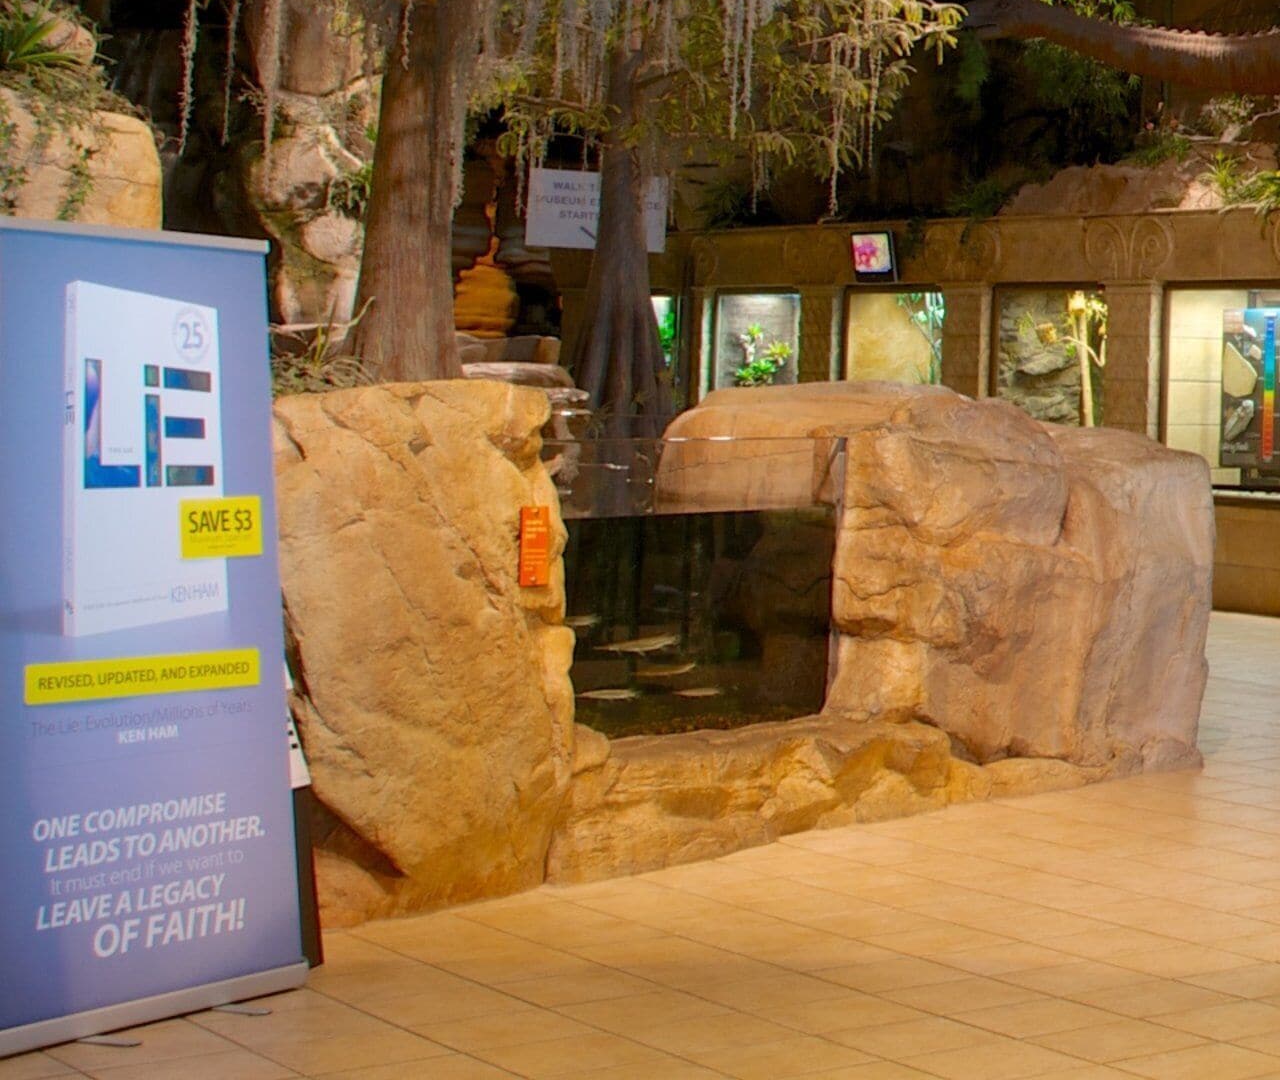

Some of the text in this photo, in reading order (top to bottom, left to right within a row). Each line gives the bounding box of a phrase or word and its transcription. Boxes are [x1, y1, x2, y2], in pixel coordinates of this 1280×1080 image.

[179, 322, 204, 349] 25
[188, 508, 253, 534] SAVE $3
[38, 661, 250, 690] REVISED, UPDATED, AND EXPANDED
[117, 724, 180, 745] KEN HAM
[32, 791, 227, 842] ONE COMPROMISE
[44, 815, 266, 873] LEADS TO ANOTHER.
[51, 848, 244, 896] It must end if we want to
[35, 872, 226, 931] LEAVE A LEGACY
[93, 897, 246, 958] OF FAITH!
